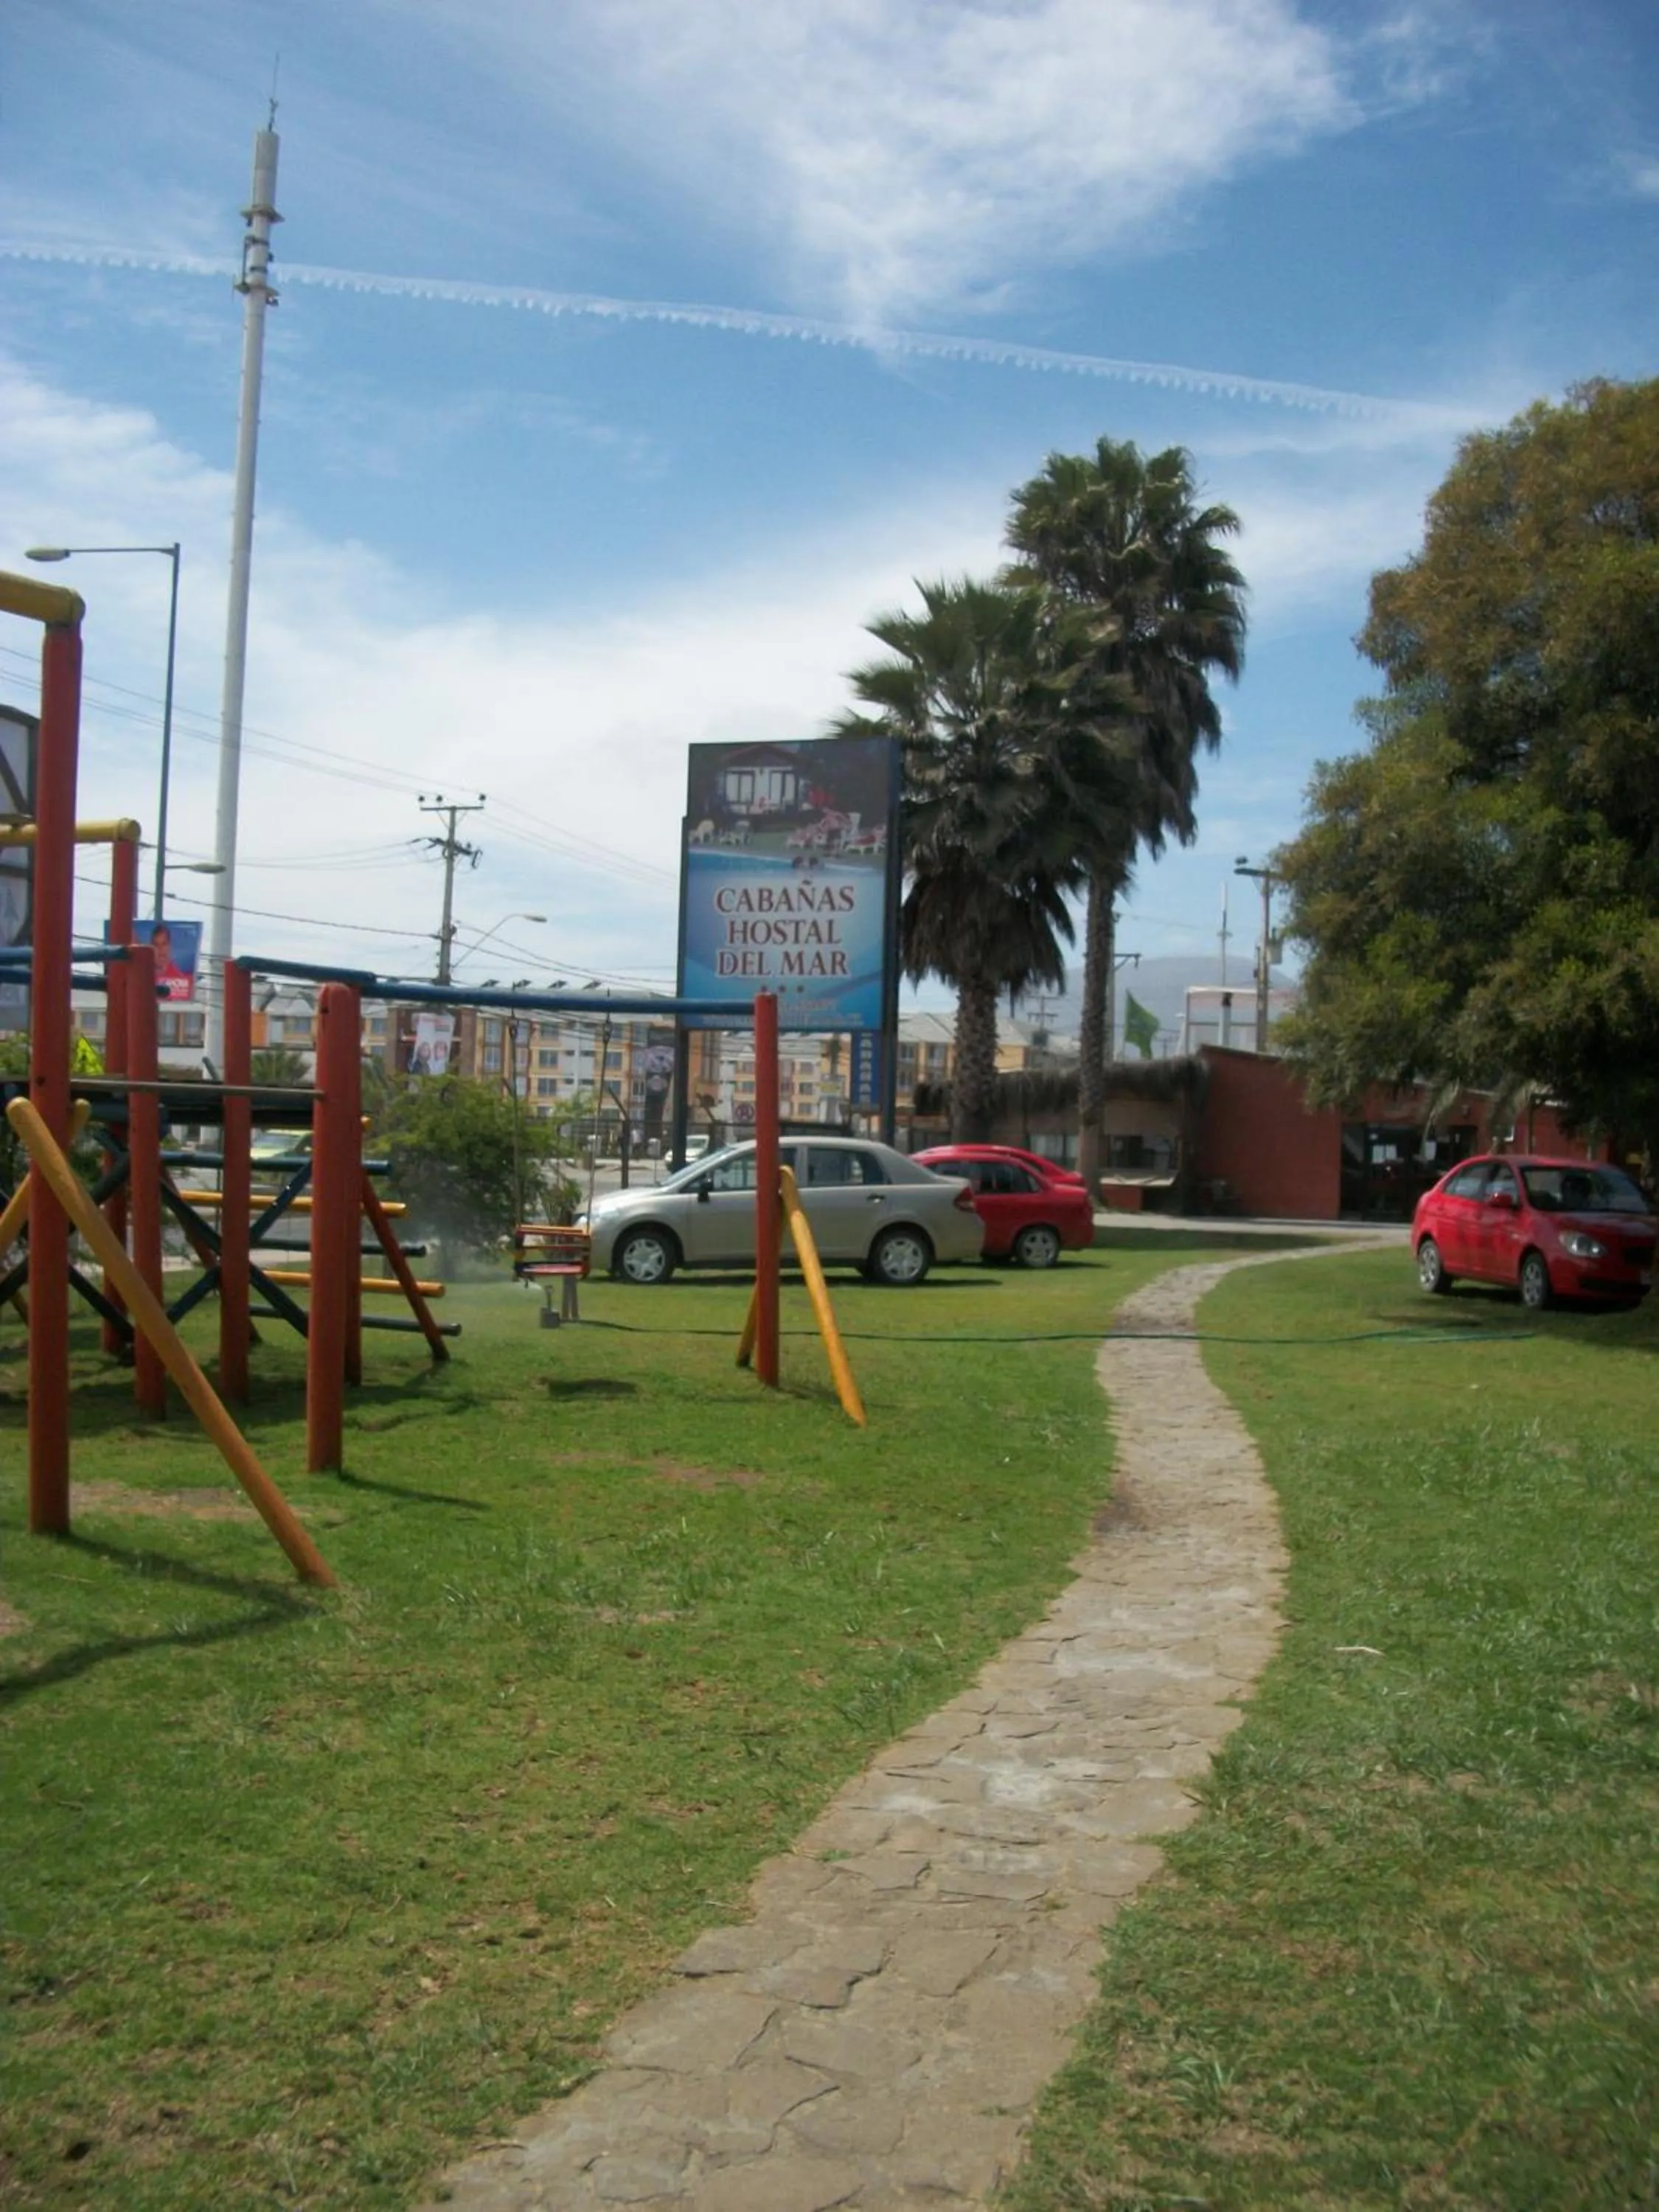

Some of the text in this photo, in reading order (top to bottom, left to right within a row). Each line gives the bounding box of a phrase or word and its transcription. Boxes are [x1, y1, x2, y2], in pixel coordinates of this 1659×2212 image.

[716, 880, 855, 913] CABAÑAS
[728, 918, 842, 945] HOSTAL
[717, 949, 849, 976] DEL MAR
